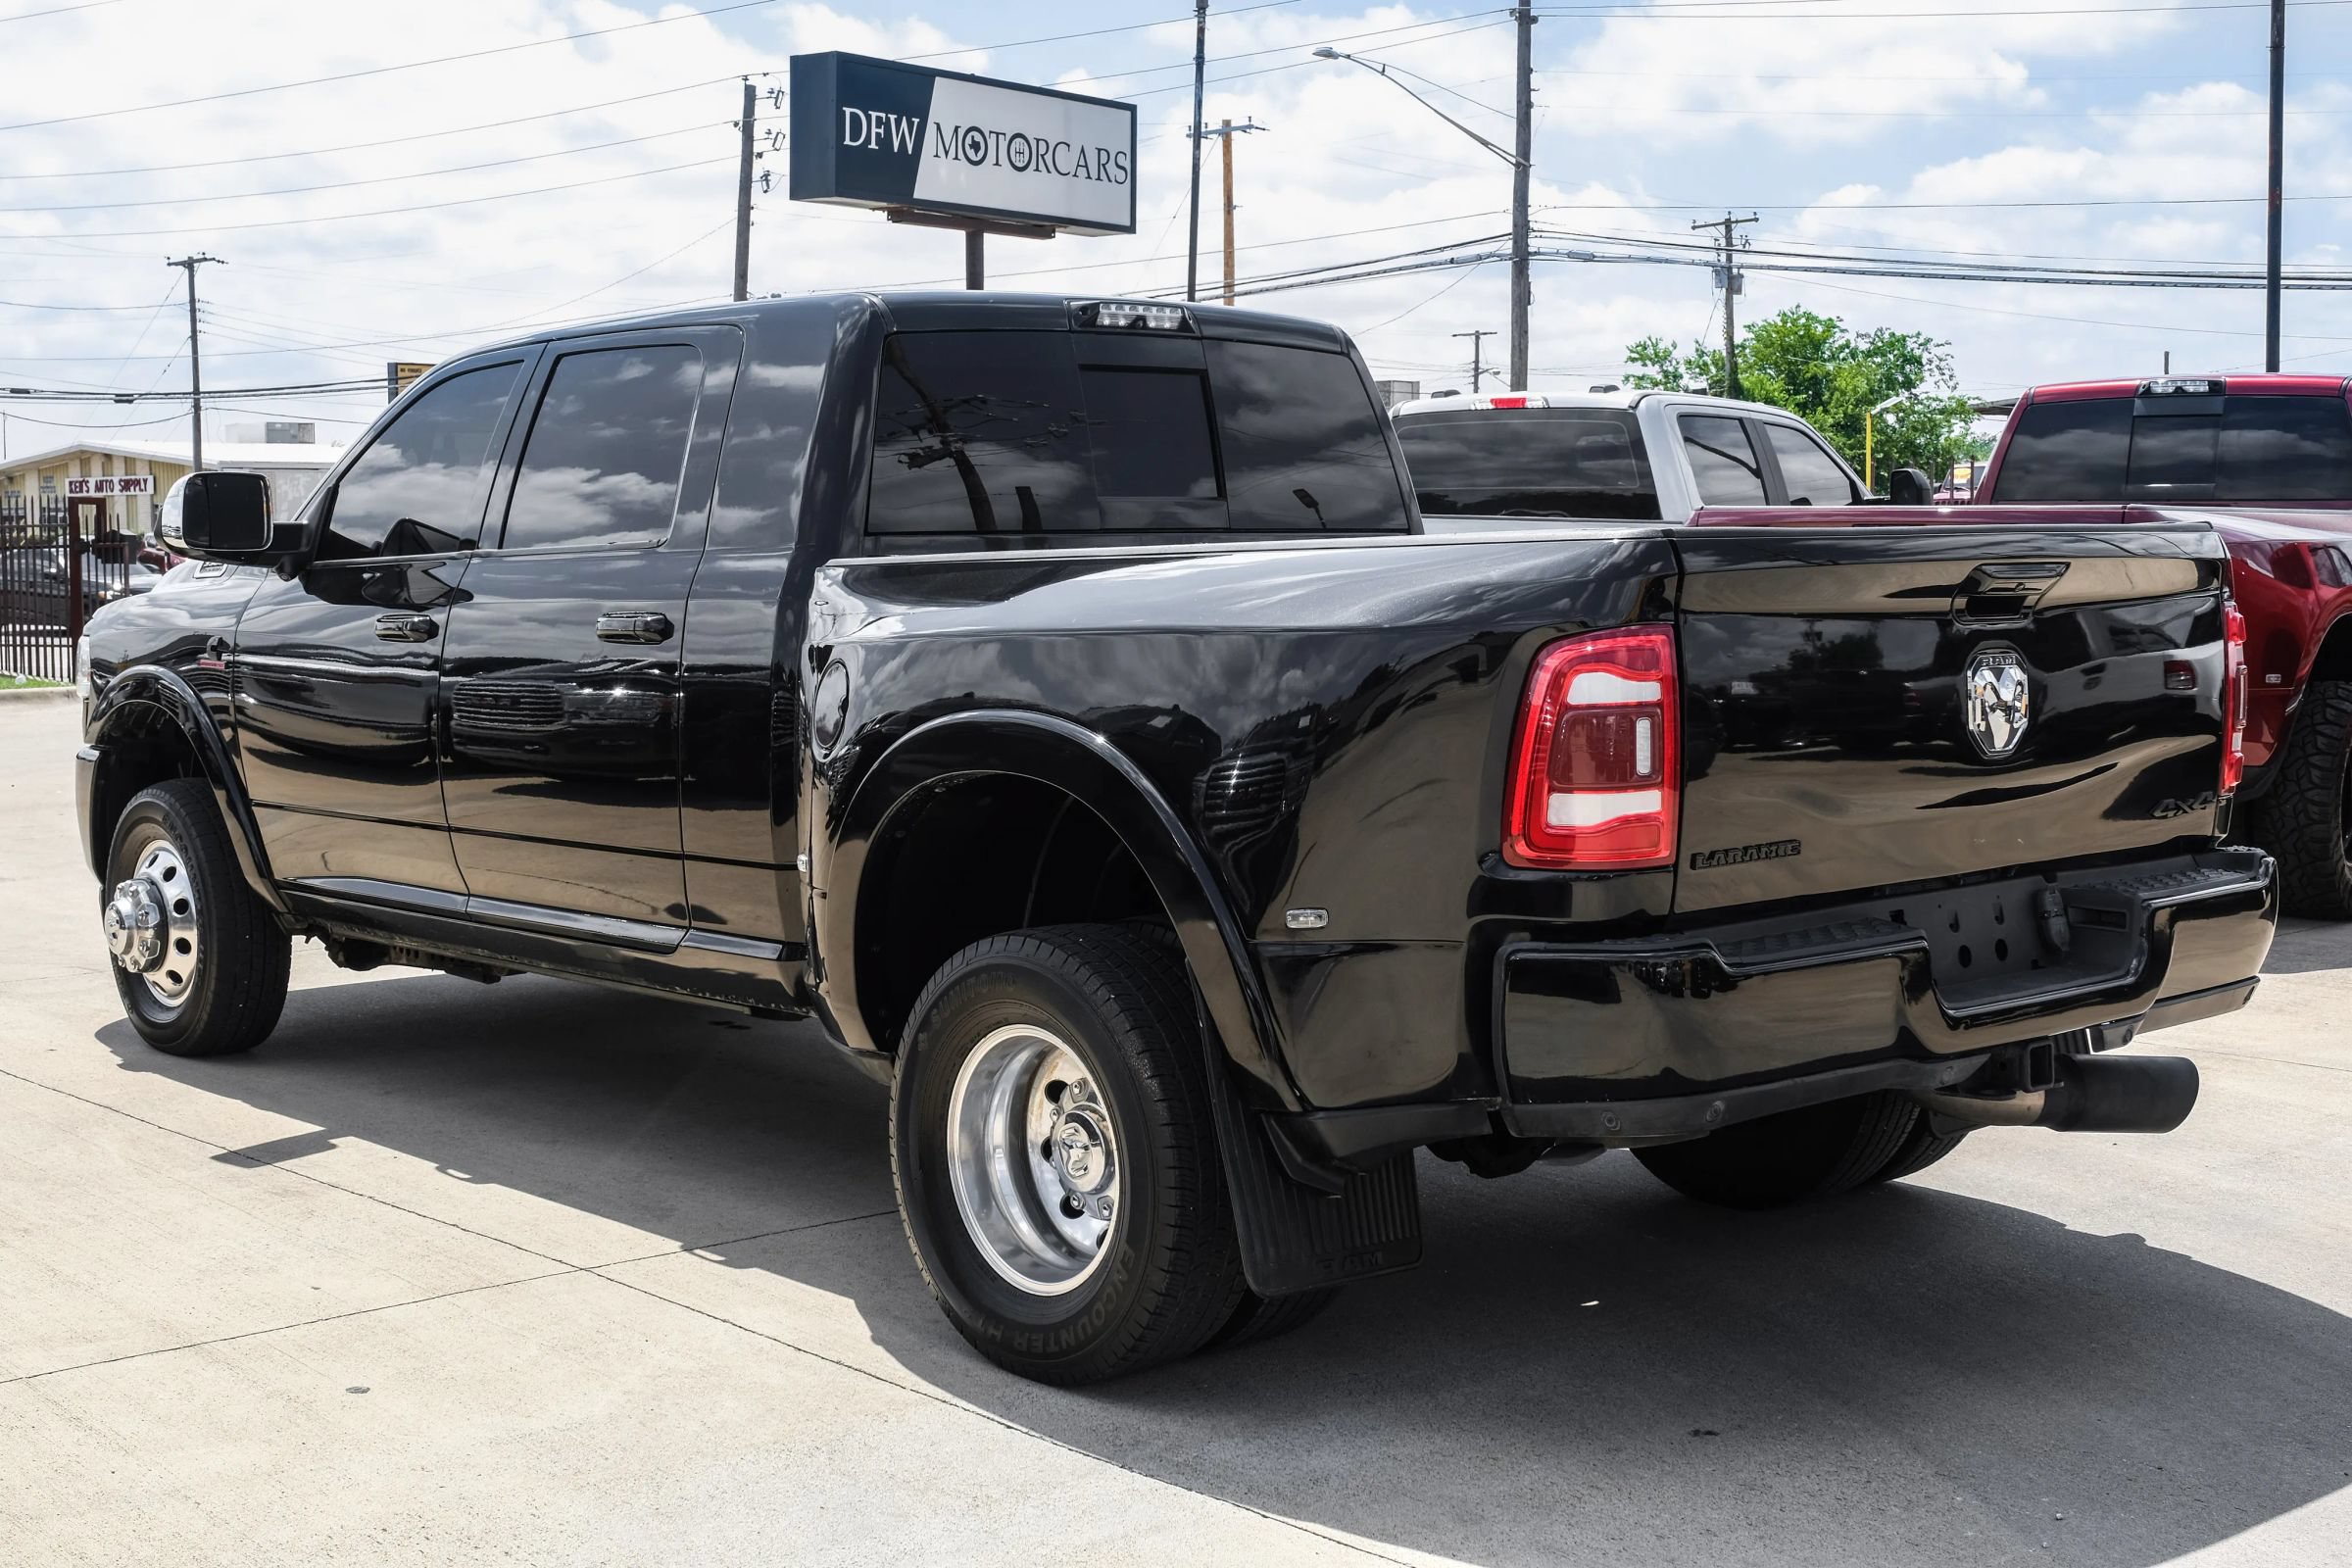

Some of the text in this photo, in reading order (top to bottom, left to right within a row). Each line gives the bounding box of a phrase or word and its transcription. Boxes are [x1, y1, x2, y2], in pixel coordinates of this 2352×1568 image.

[842, 106, 1129, 185] DFW MOTORCARS
[69, 478, 90, 494] KEN'S
[94, 478, 115, 494] AUTO
[119, 477, 148, 493] SUPPLY
[1981, 655, 2016, 666] RAM
[1690, 839, 1801, 870] LARAMIE
[1011, 1245, 1136, 1353] ENCOUNTER
